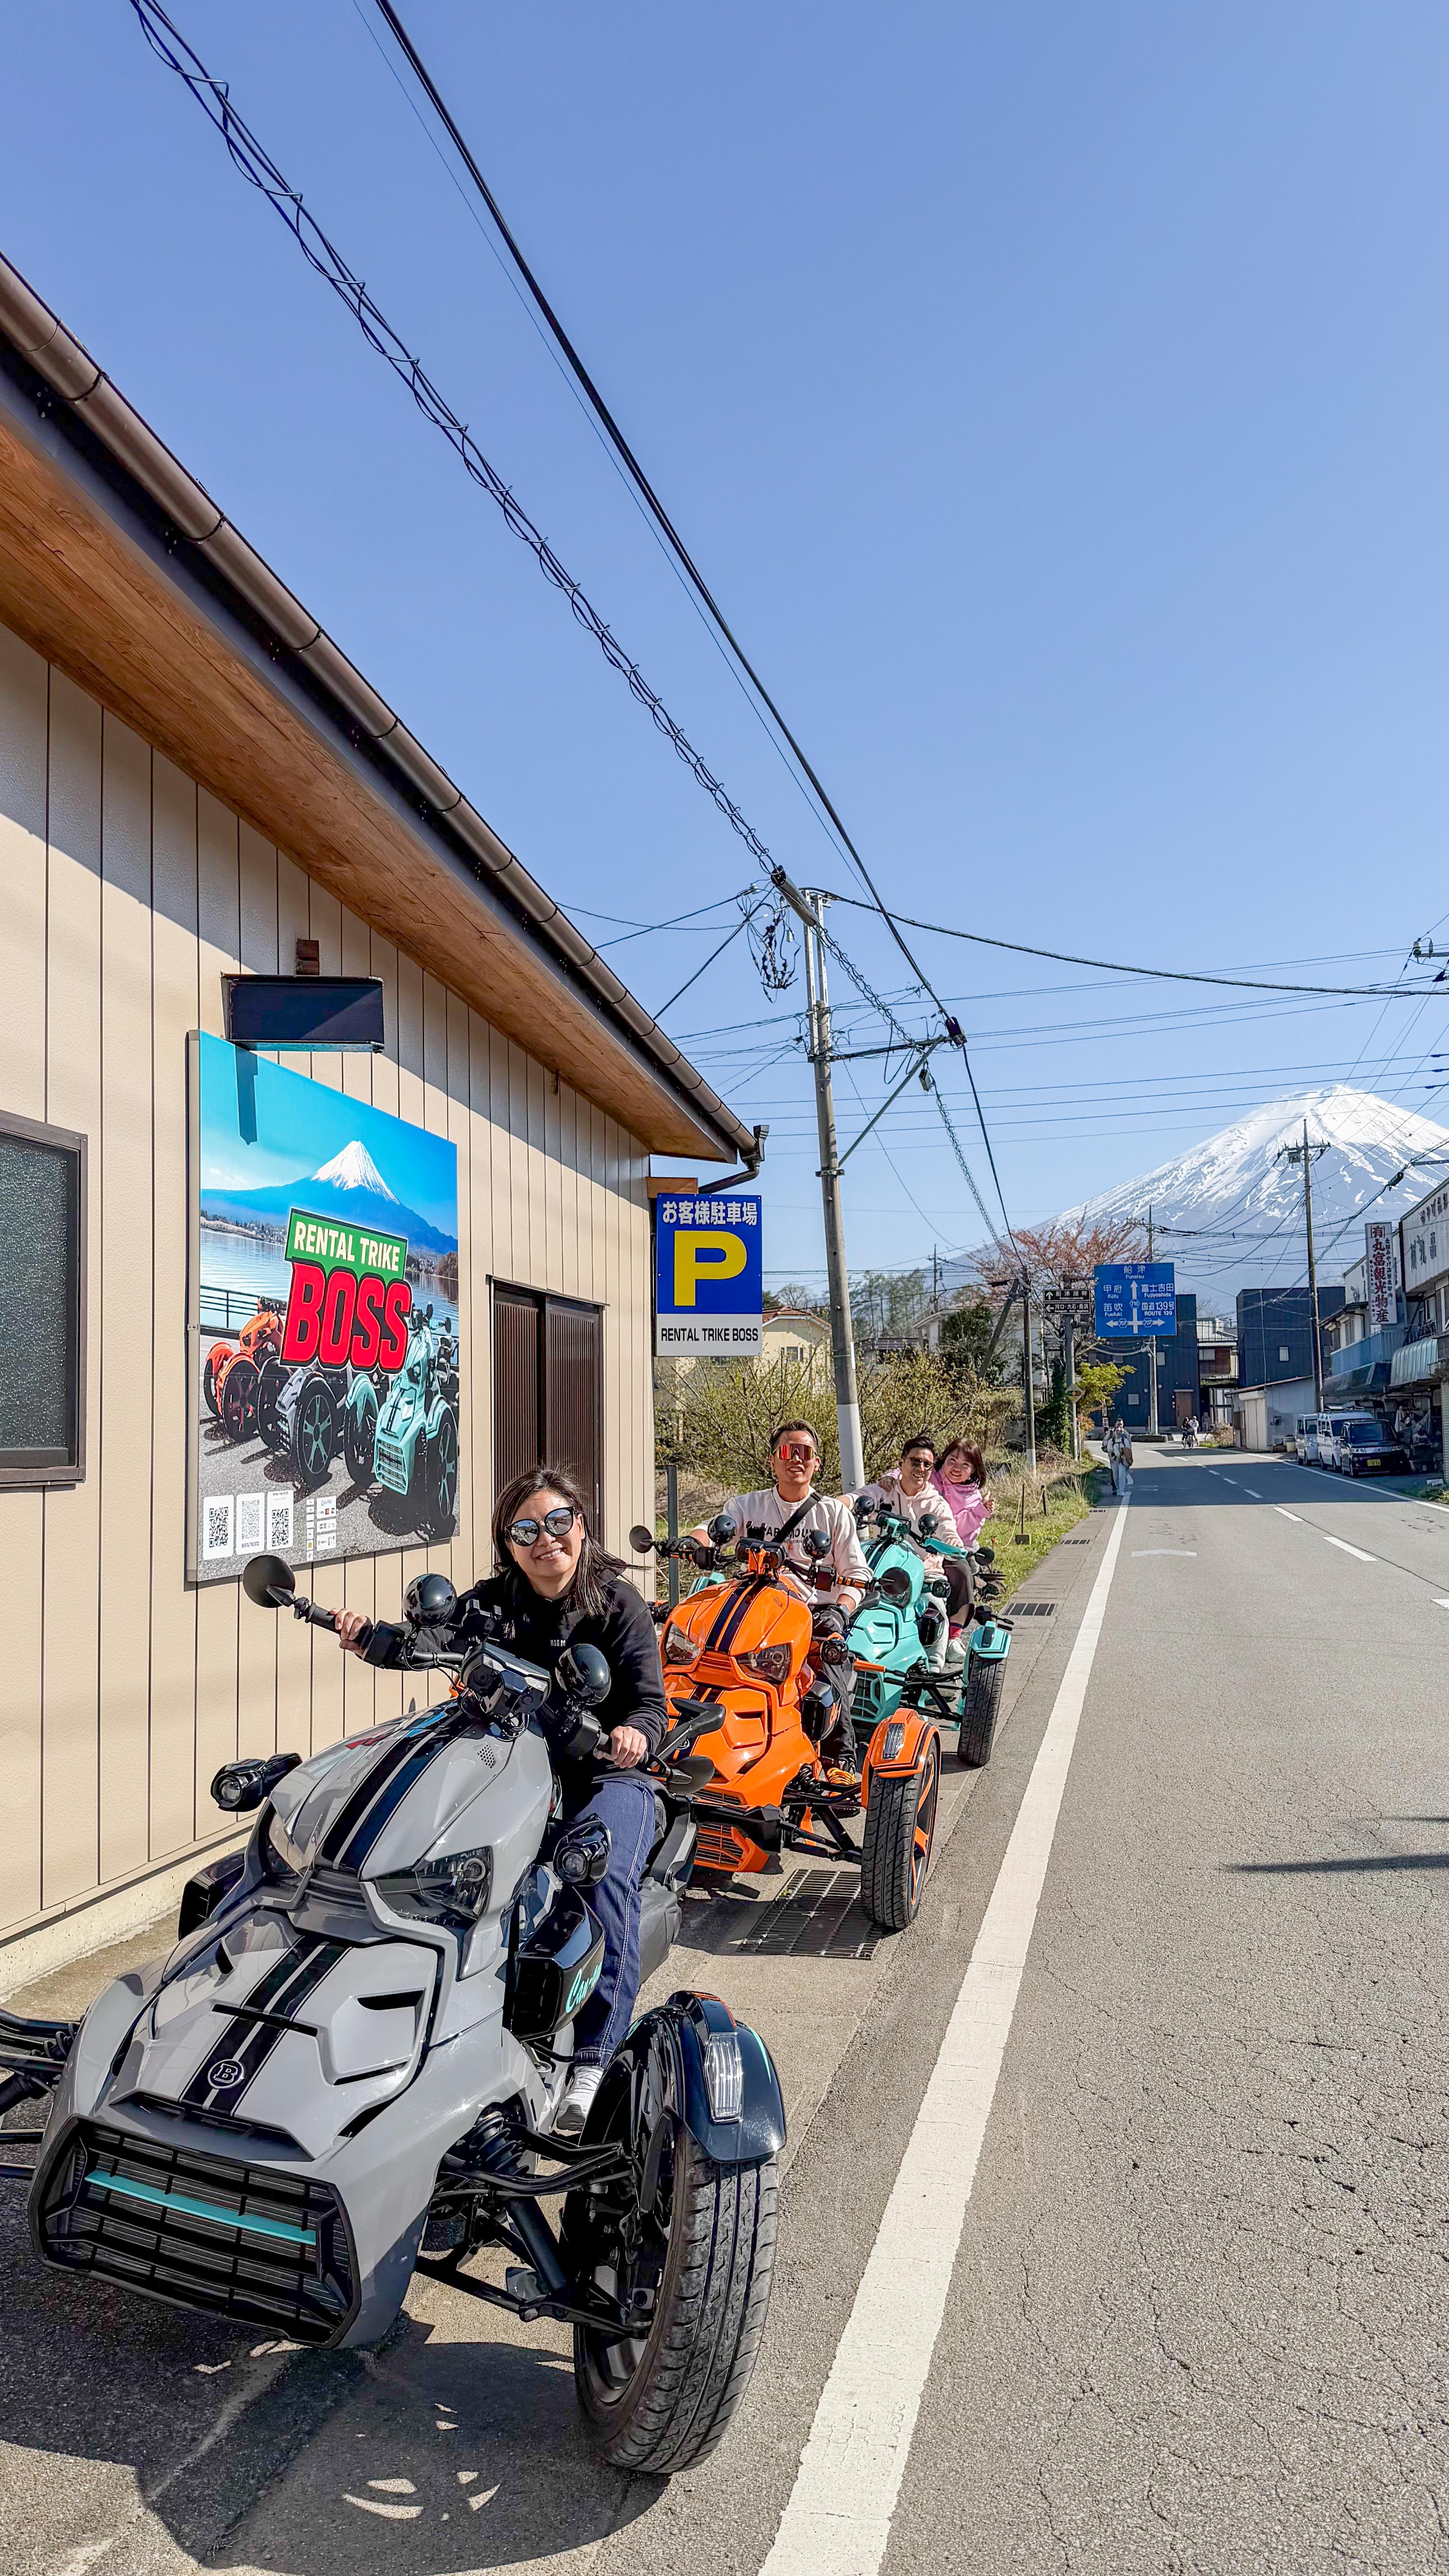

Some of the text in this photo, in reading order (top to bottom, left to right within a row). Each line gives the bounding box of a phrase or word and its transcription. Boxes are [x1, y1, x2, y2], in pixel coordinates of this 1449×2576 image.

[662, 1201, 757, 1226] お客様駐車場
[294, 1221, 400, 1272] RENTAL TRIKE
[674, 1230, 747, 1306] P
[1123, 1265, 1145, 1274] 船津
[1104, 1284, 1122, 1293] 甲府
[1141, 1283, 1174, 1293] 富士吉田
[1104, 1303, 1123, 1311] 笛吹
[1141, 1301, 1174, 1311] 国道139号
[282, 1261, 411, 1369] BOSS
[661, 1328, 759, 1341] RENTAL TRIKE BOSS
